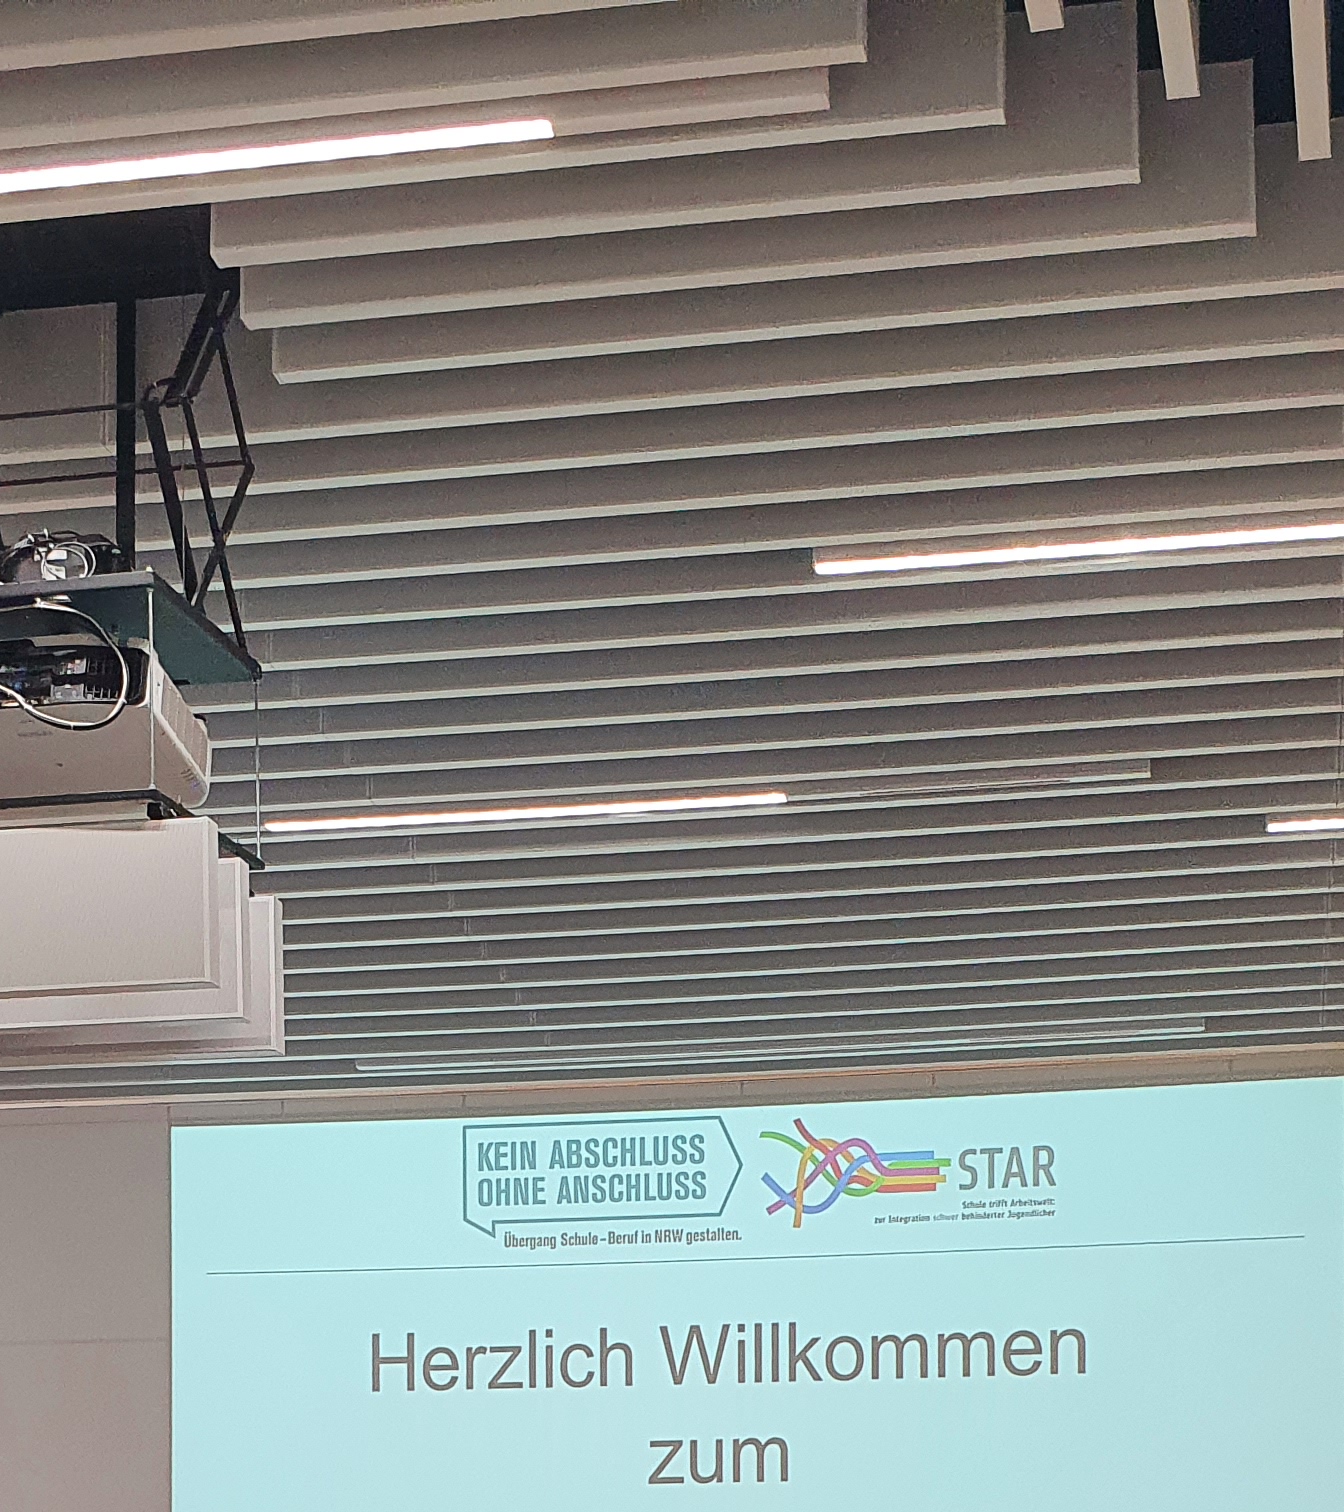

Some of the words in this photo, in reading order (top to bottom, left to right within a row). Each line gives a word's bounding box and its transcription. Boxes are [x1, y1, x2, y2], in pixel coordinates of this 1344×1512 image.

[477, 1141, 537, 1171] KEIN
[549, 1134, 705, 1169] ABSCHLUSS
[959, 1145, 1056, 1190] STAR
[477, 1177, 546, 1206] OHNE
[557, 1171, 707, 1204] ANSCHLUSS
[962, 1199, 986, 1208] Schule
[888, 1213, 930, 1224] Integration
[504, 1230, 557, 1250] Übergang
[641, 1230, 651, 1244] in
[655, 1228, 684, 1244] NRW
[686, 1227, 742, 1245] gestalten.
[370, 1327, 634, 1392] Herzlich
[659, 1321, 1087, 1385] Willkommen
[647, 1436, 790, 1486] zum
